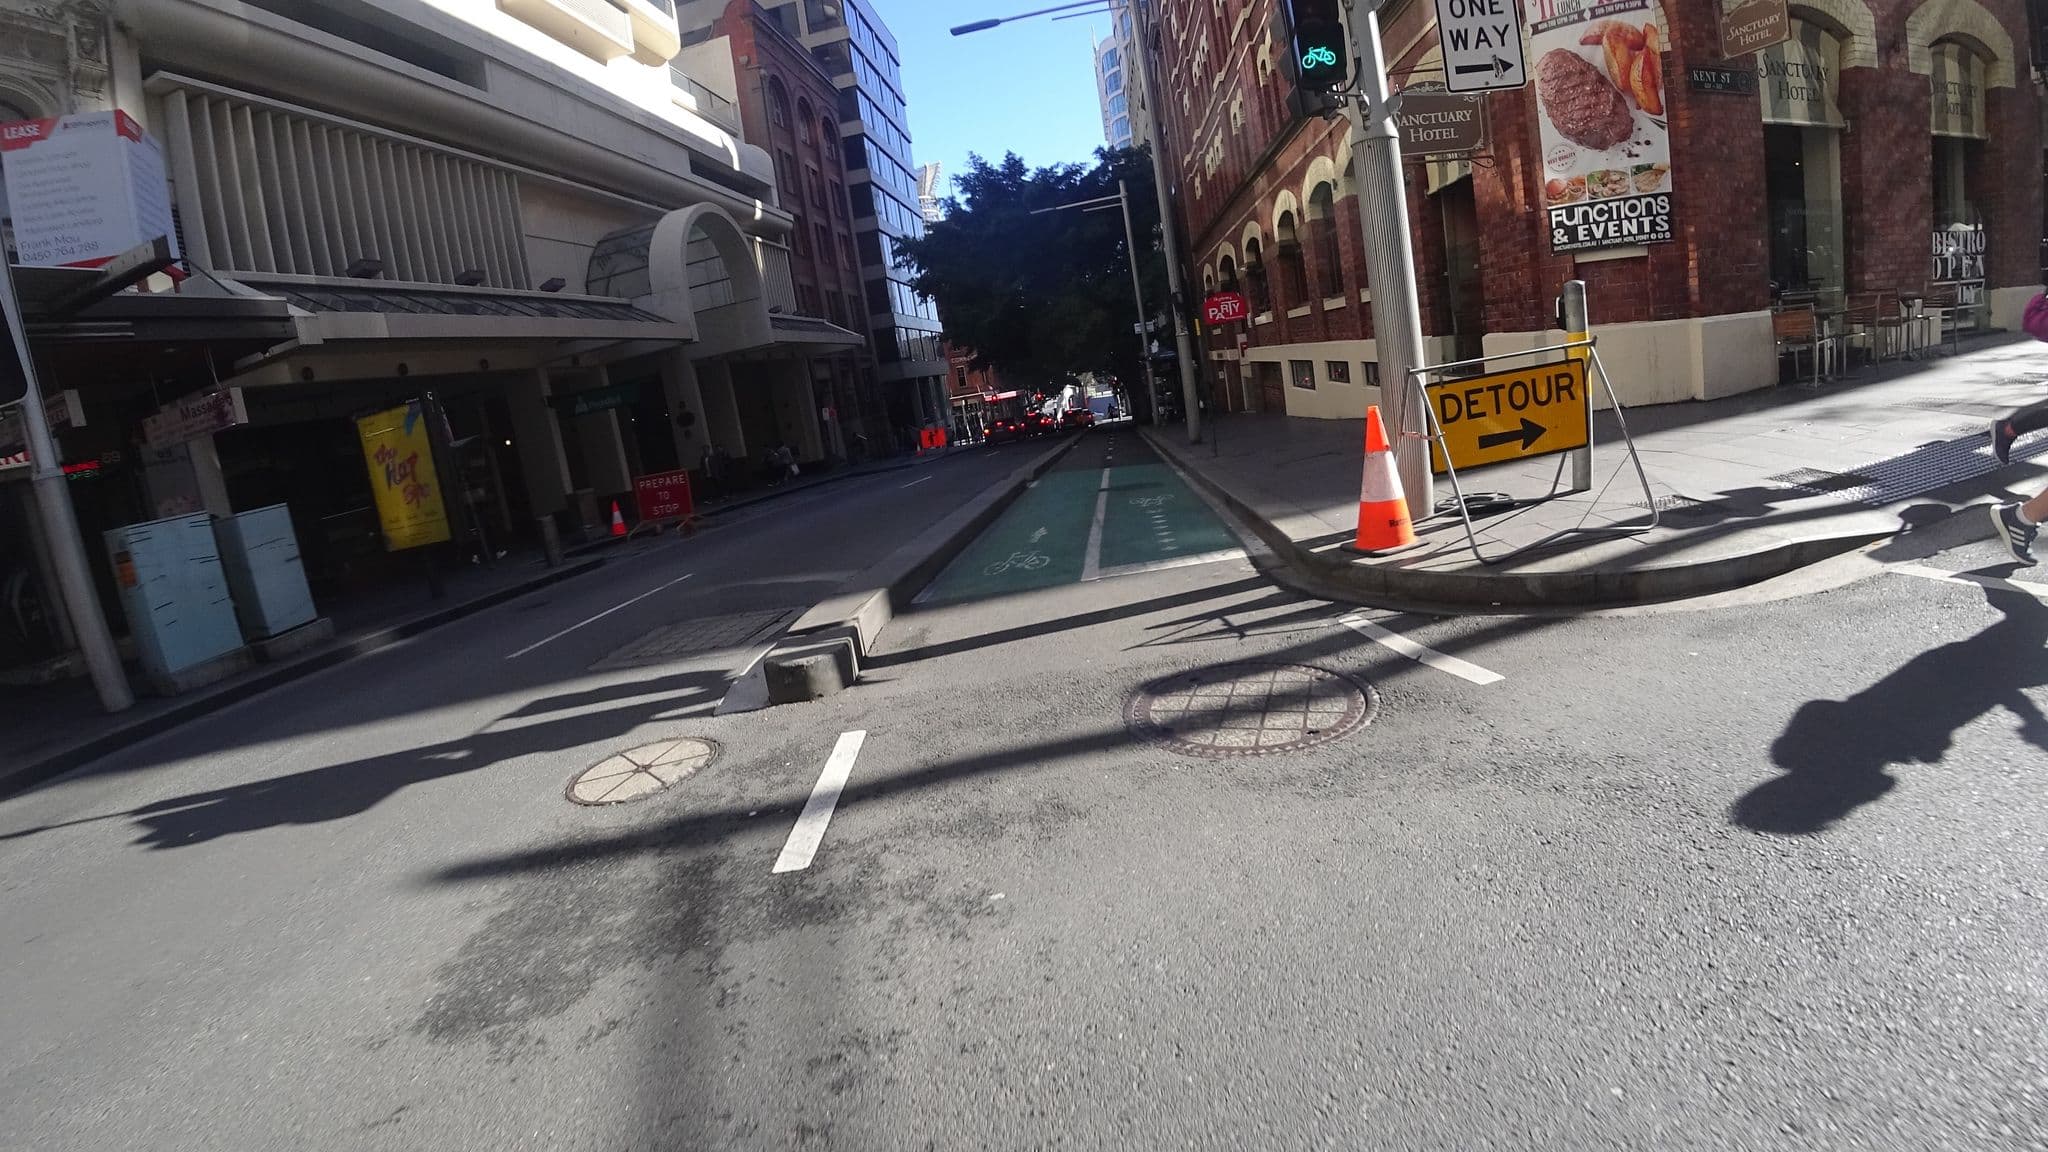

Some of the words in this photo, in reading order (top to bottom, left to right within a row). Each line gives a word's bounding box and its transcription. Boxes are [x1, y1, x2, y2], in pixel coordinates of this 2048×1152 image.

[1449, 0, 1504, 19] ONE
[1727, 12, 1781, 41] SANCTUARY
[1448, 23, 1510, 52] WAY
[1739, 29, 1772, 47] HOTEL
[1693, 70, 1717, 83] KENT
[1721, 72, 1731, 83] ST
[1779, 80, 1824, 102] HOTEL
[1391, 110, 1473, 129] SANCTUARY
[4, 124, 41, 140] LEASE
[1409, 127, 1459, 142] HOTEL
[1552, 228, 1569, 245] &
[1577, 216, 1669, 242] EVENTS
[1932, 230, 1986, 255] BISTRO
[1932, 254, 1985, 280] OPEN
[1208, 300, 1240, 321] PARTY
[1439, 372, 1576, 425] DETOUR
[639, 474, 686, 488] PREPARE
[656, 491, 669, 500] TO
[652, 503, 680, 516] STOP
